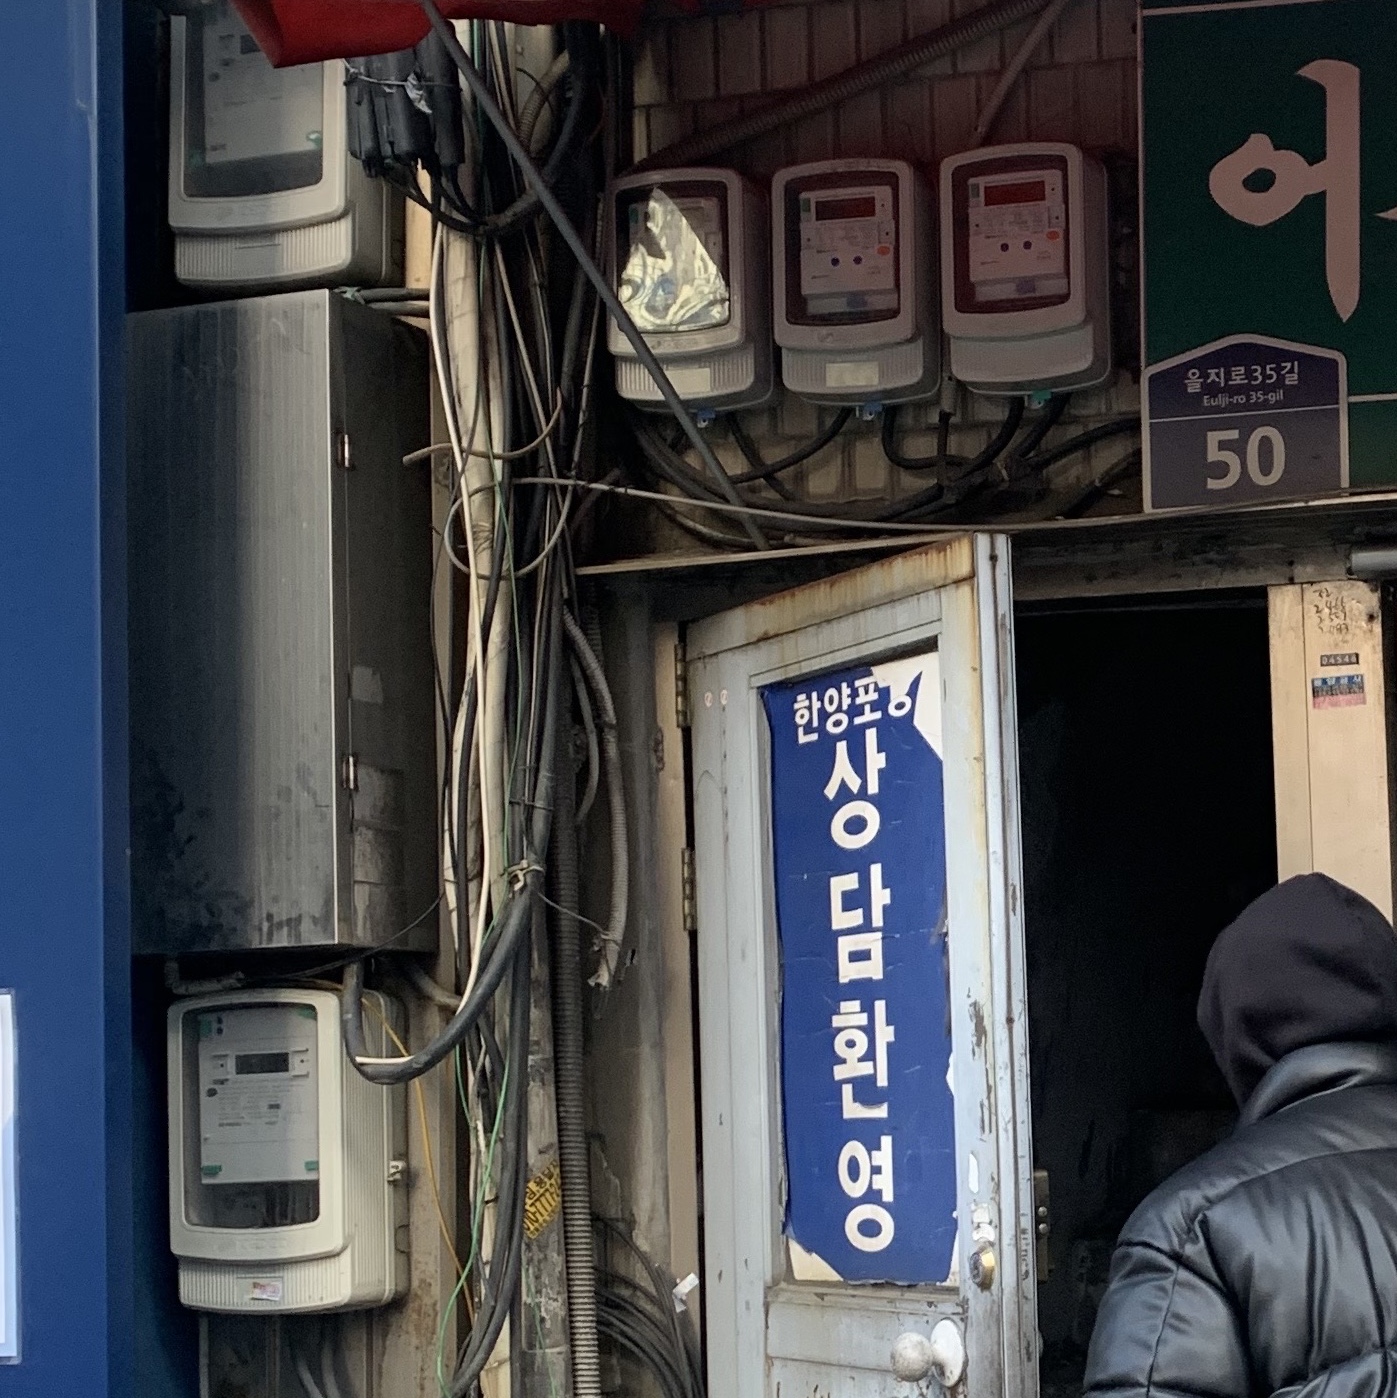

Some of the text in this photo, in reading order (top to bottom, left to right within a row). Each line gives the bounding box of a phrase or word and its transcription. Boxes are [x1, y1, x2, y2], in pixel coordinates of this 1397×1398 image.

[1184, 361, 1299, 393] 을지로35길
[1203, 389, 1284, 408] Eulji-ro 35-gil
[1206, 425, 1286, 490] 50
